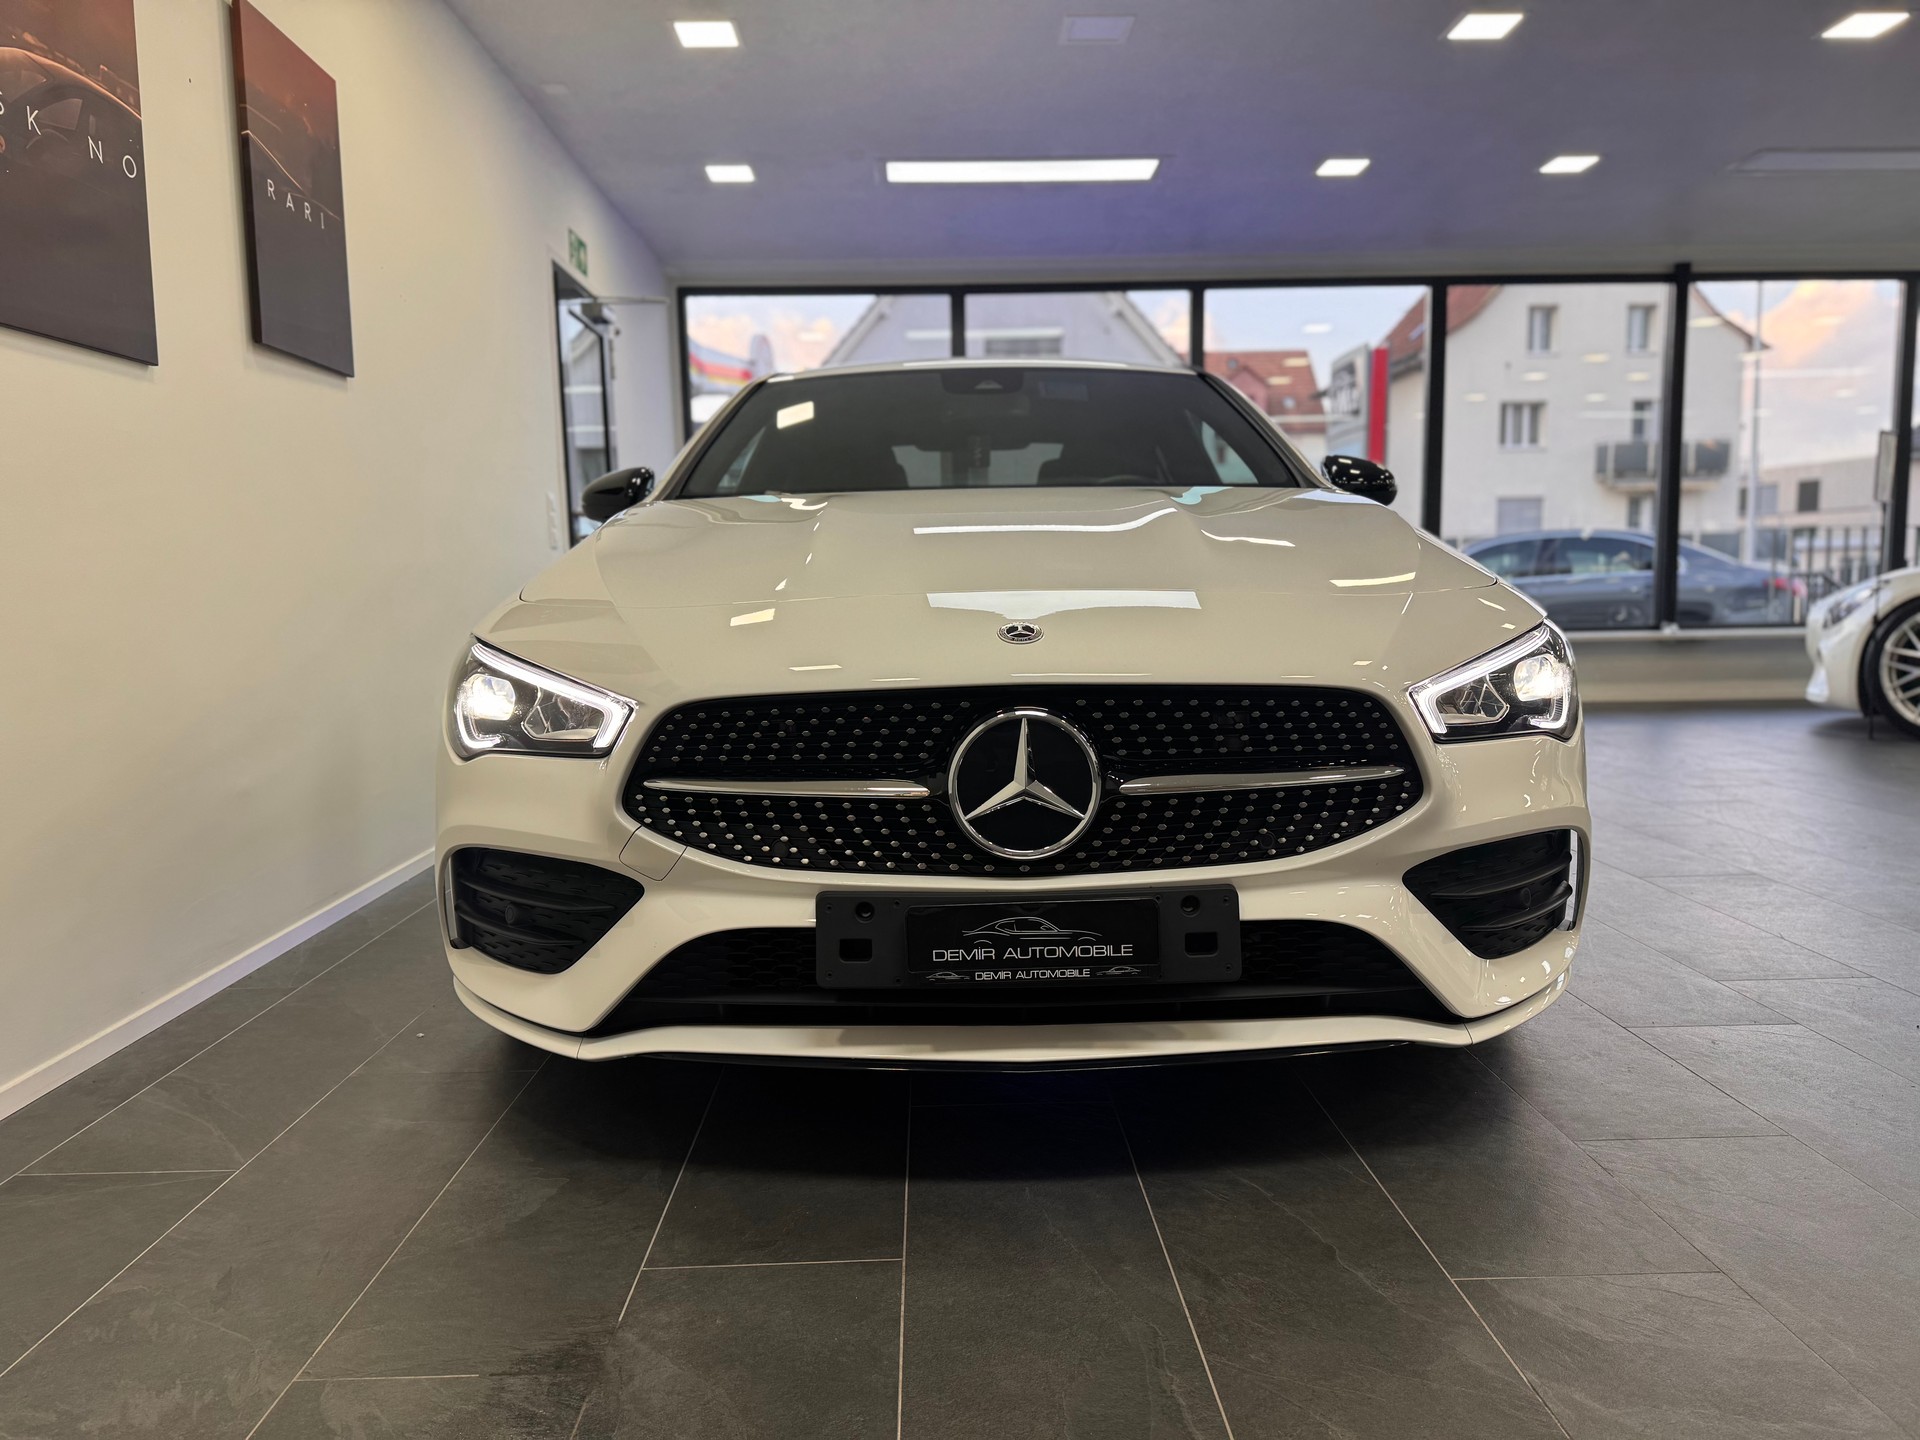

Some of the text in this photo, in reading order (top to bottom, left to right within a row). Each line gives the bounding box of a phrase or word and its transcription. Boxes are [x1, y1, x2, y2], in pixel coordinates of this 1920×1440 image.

[88, 136, 138, 178] NO
[267, 179, 325, 229] RARI
[1003, 944, 1134, 960] AUTOMOBILE
[1015, 968, 1091, 980] AUTOMOBILE
